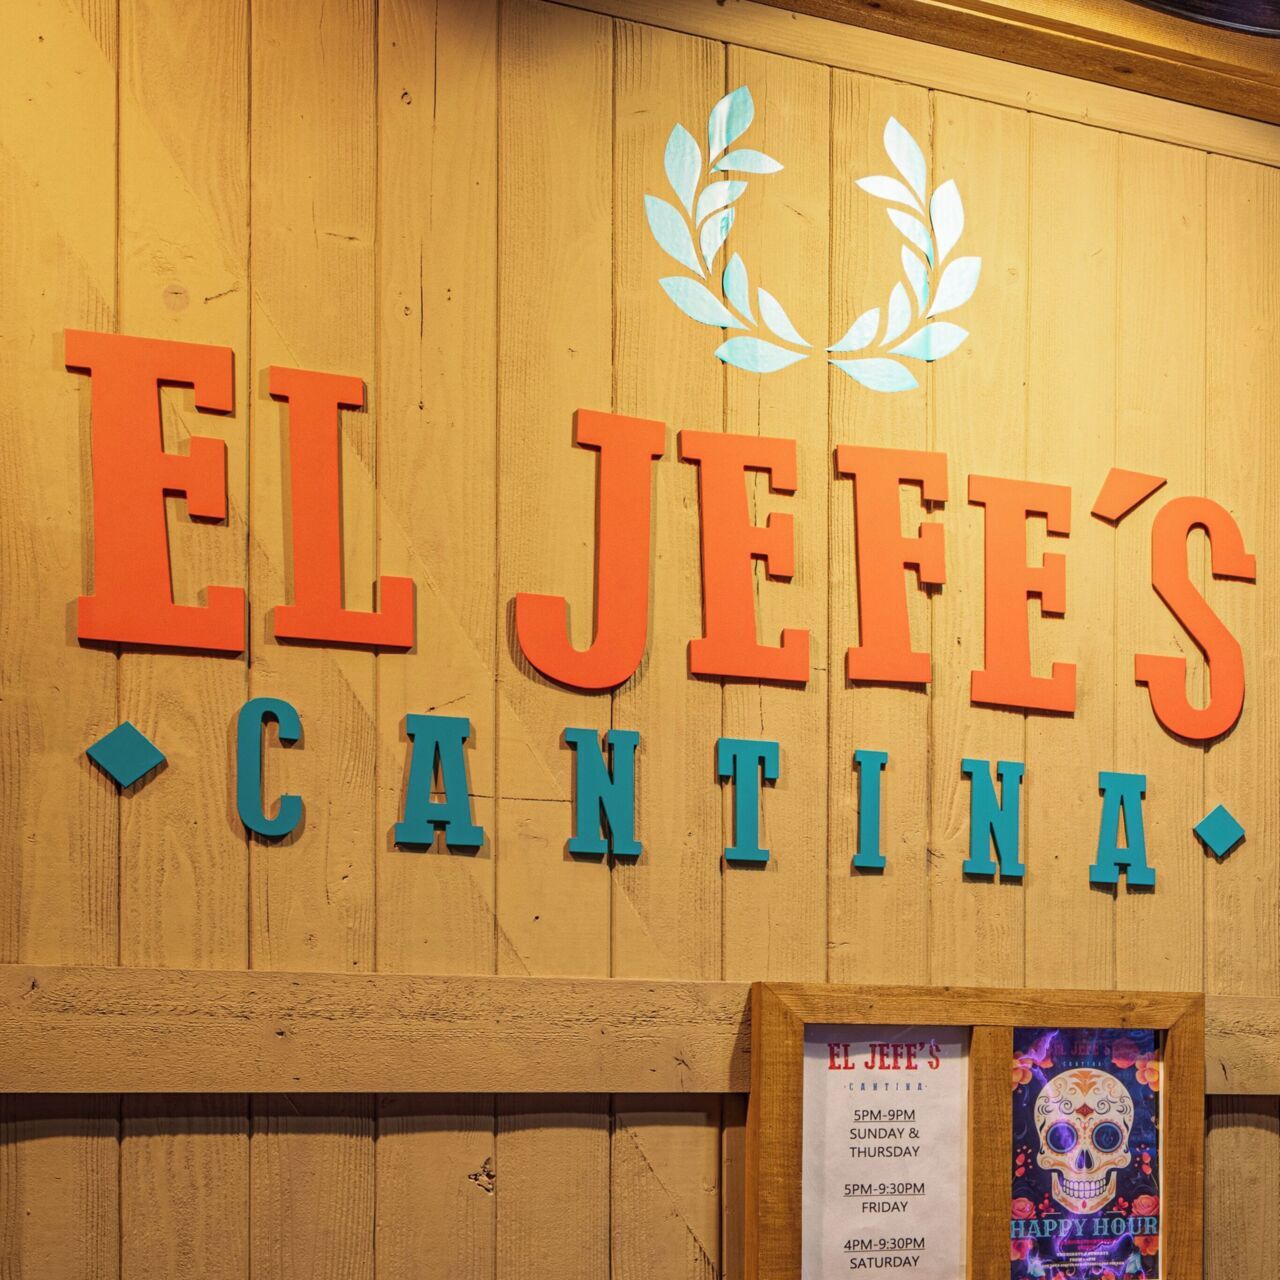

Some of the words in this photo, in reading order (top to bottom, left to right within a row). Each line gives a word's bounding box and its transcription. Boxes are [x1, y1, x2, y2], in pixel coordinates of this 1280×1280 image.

[65, 328, 416, 655] EL
[236, 697, 1157, 889] CANTINA
[828, 1043, 856, 1071] EL
[864, 1040, 942, 1071] JEFE'S
[848, 1082, 924, 1092] CANTINA
[853, 1108, 916, 1123] 5PM-9PM
[849, 1127, 905, 1141] SUNDAY
[908, 1127, 920, 1140] &
[849, 1145, 920, 1159] THURSDAY
[844, 1182, 926, 1197] 5PM-9:30PM
[861, 1201, 909, 1214] FRIDAY
[1011, 1218, 1088, 1239] HAPPY
[1092, 1216, 1158, 1237] HOUR
[844, 1237, 926, 1252] 4PM-9:30PM
[849, 1256, 921, 1270] SATURDAY
